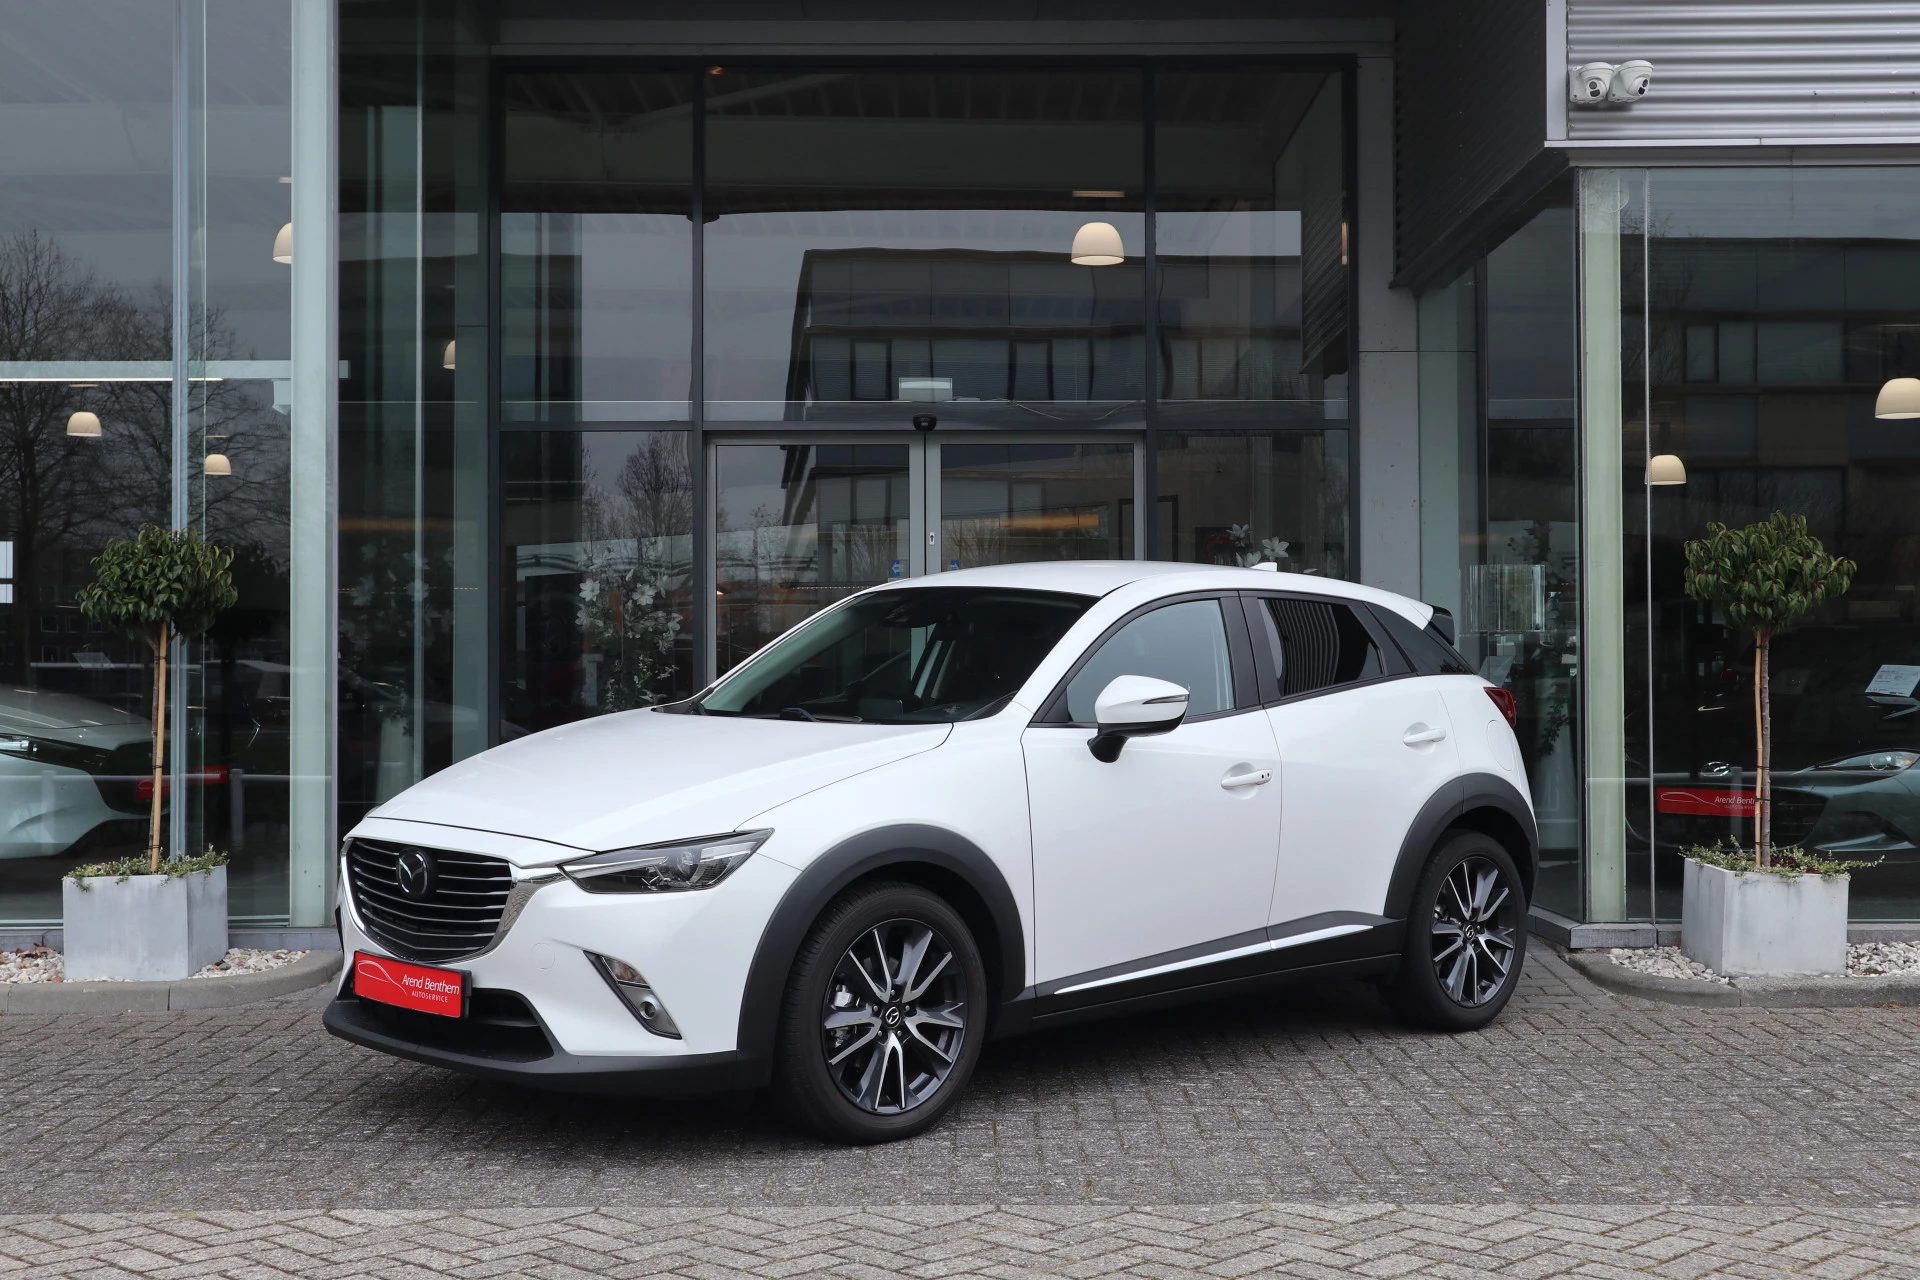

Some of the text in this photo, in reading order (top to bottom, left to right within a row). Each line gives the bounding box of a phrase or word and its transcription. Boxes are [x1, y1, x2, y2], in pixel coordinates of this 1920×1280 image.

[1715, 796, 1735, 804] Arend
[402, 974, 460, 995] Arend Benthem
[412, 991, 448, 1003] AUTOSERVICE
